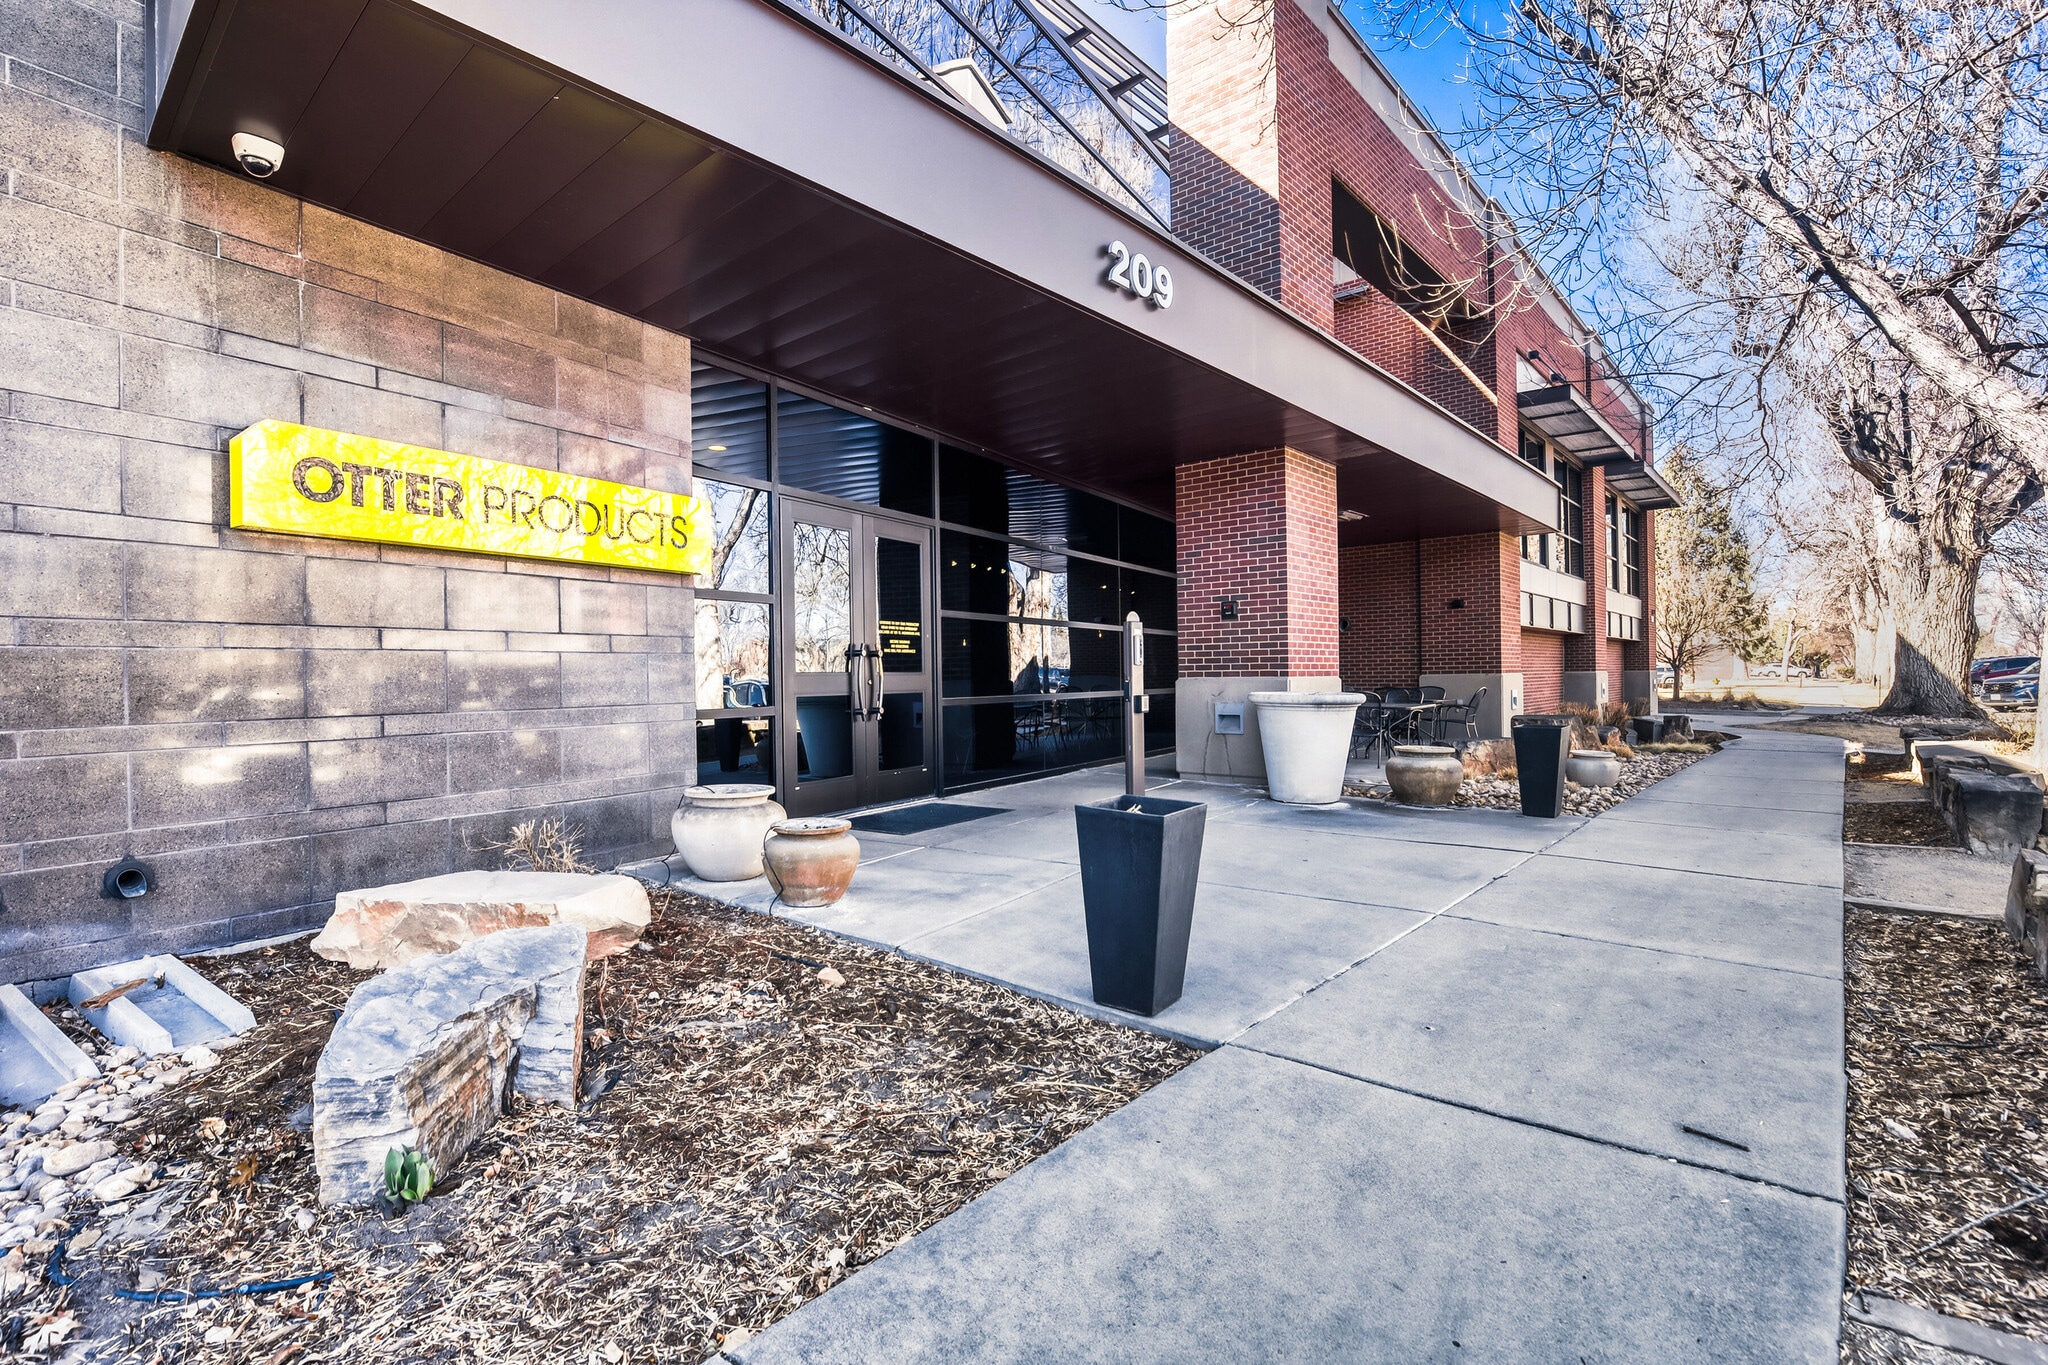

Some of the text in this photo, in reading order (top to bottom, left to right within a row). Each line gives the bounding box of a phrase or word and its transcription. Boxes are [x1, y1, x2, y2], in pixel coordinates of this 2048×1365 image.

[1108, 240, 1173, 309] 209
[292, 456, 688, 549] OTTER PRODUCTS
